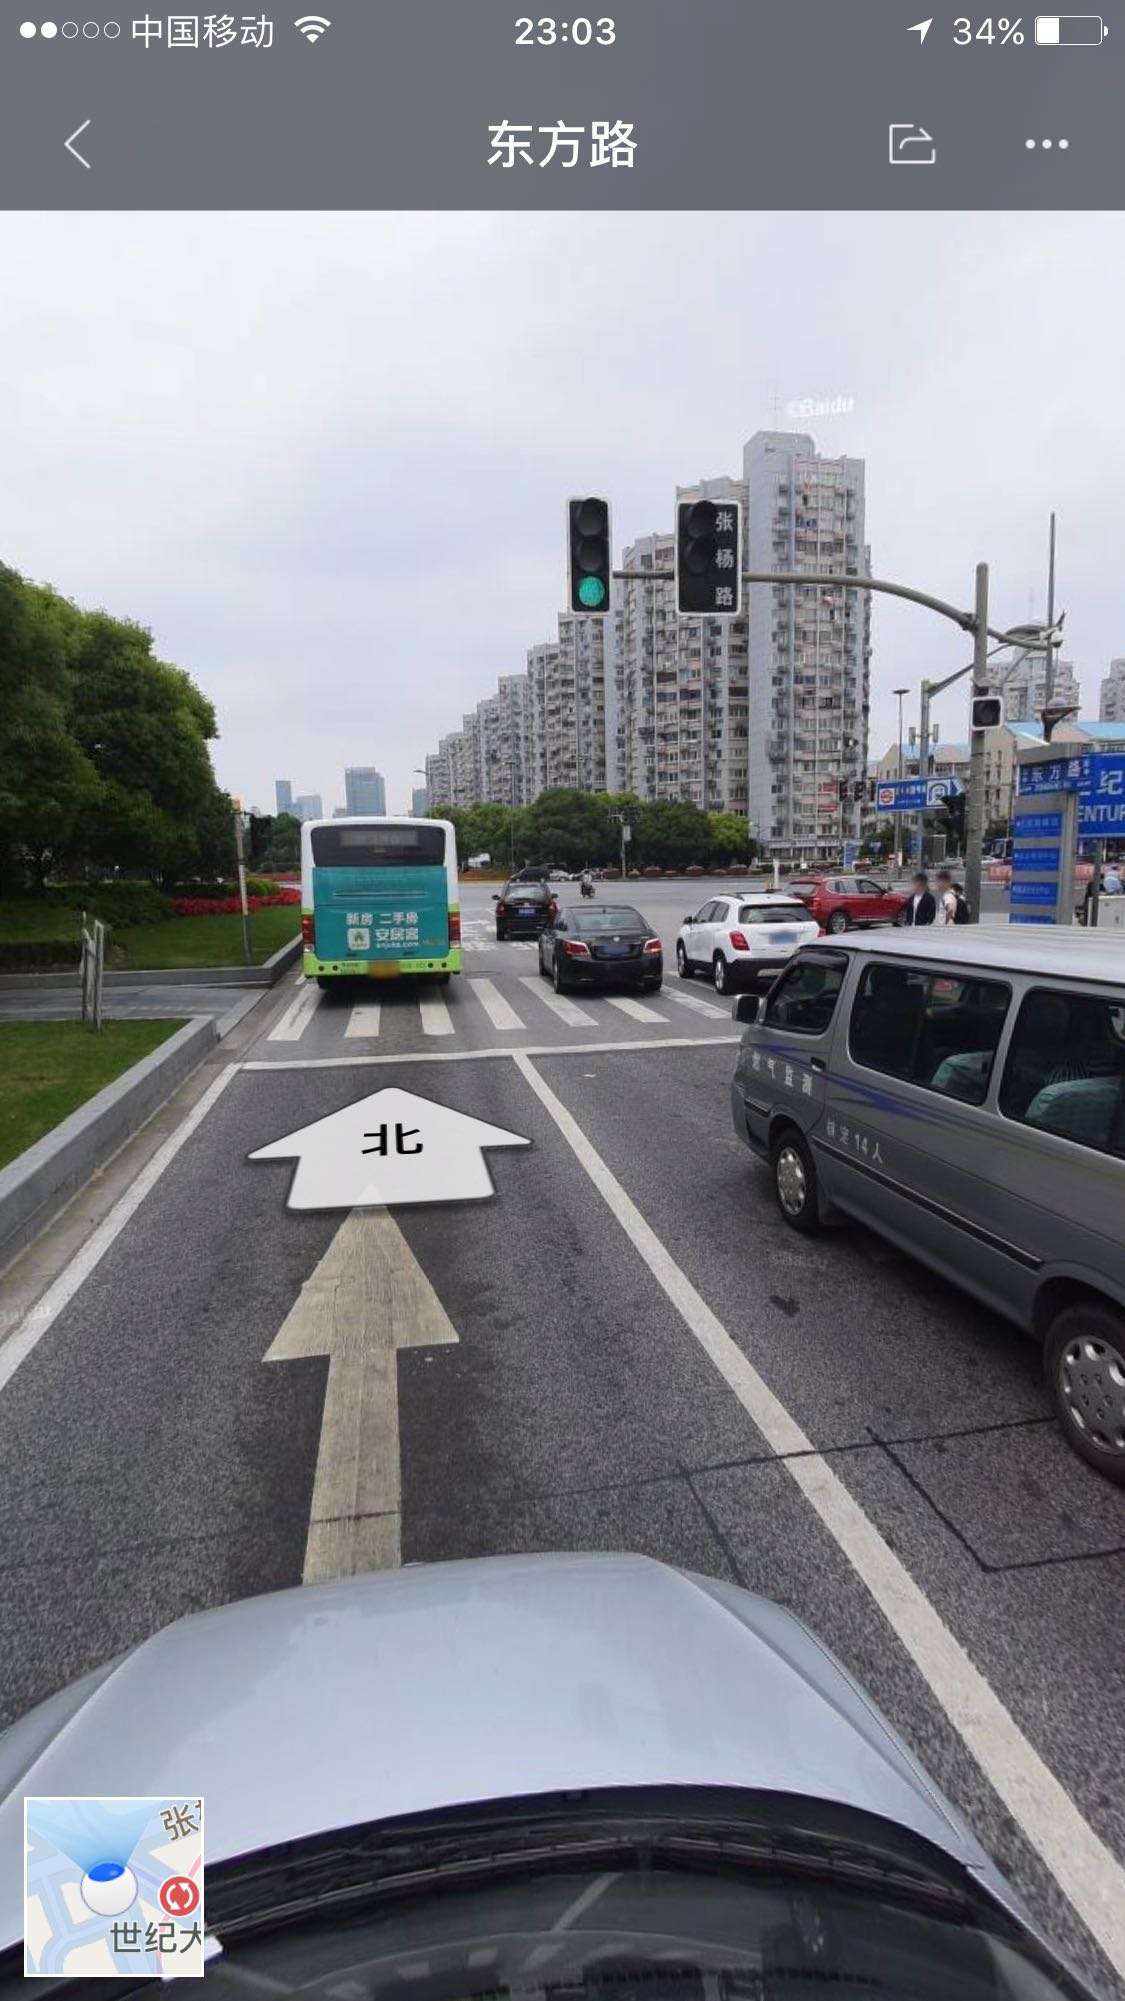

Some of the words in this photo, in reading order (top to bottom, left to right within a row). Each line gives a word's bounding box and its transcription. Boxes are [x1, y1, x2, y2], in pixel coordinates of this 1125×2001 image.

[715, 512, 734, 606] 张杨路
[375, 927, 419, 941] 安居客
